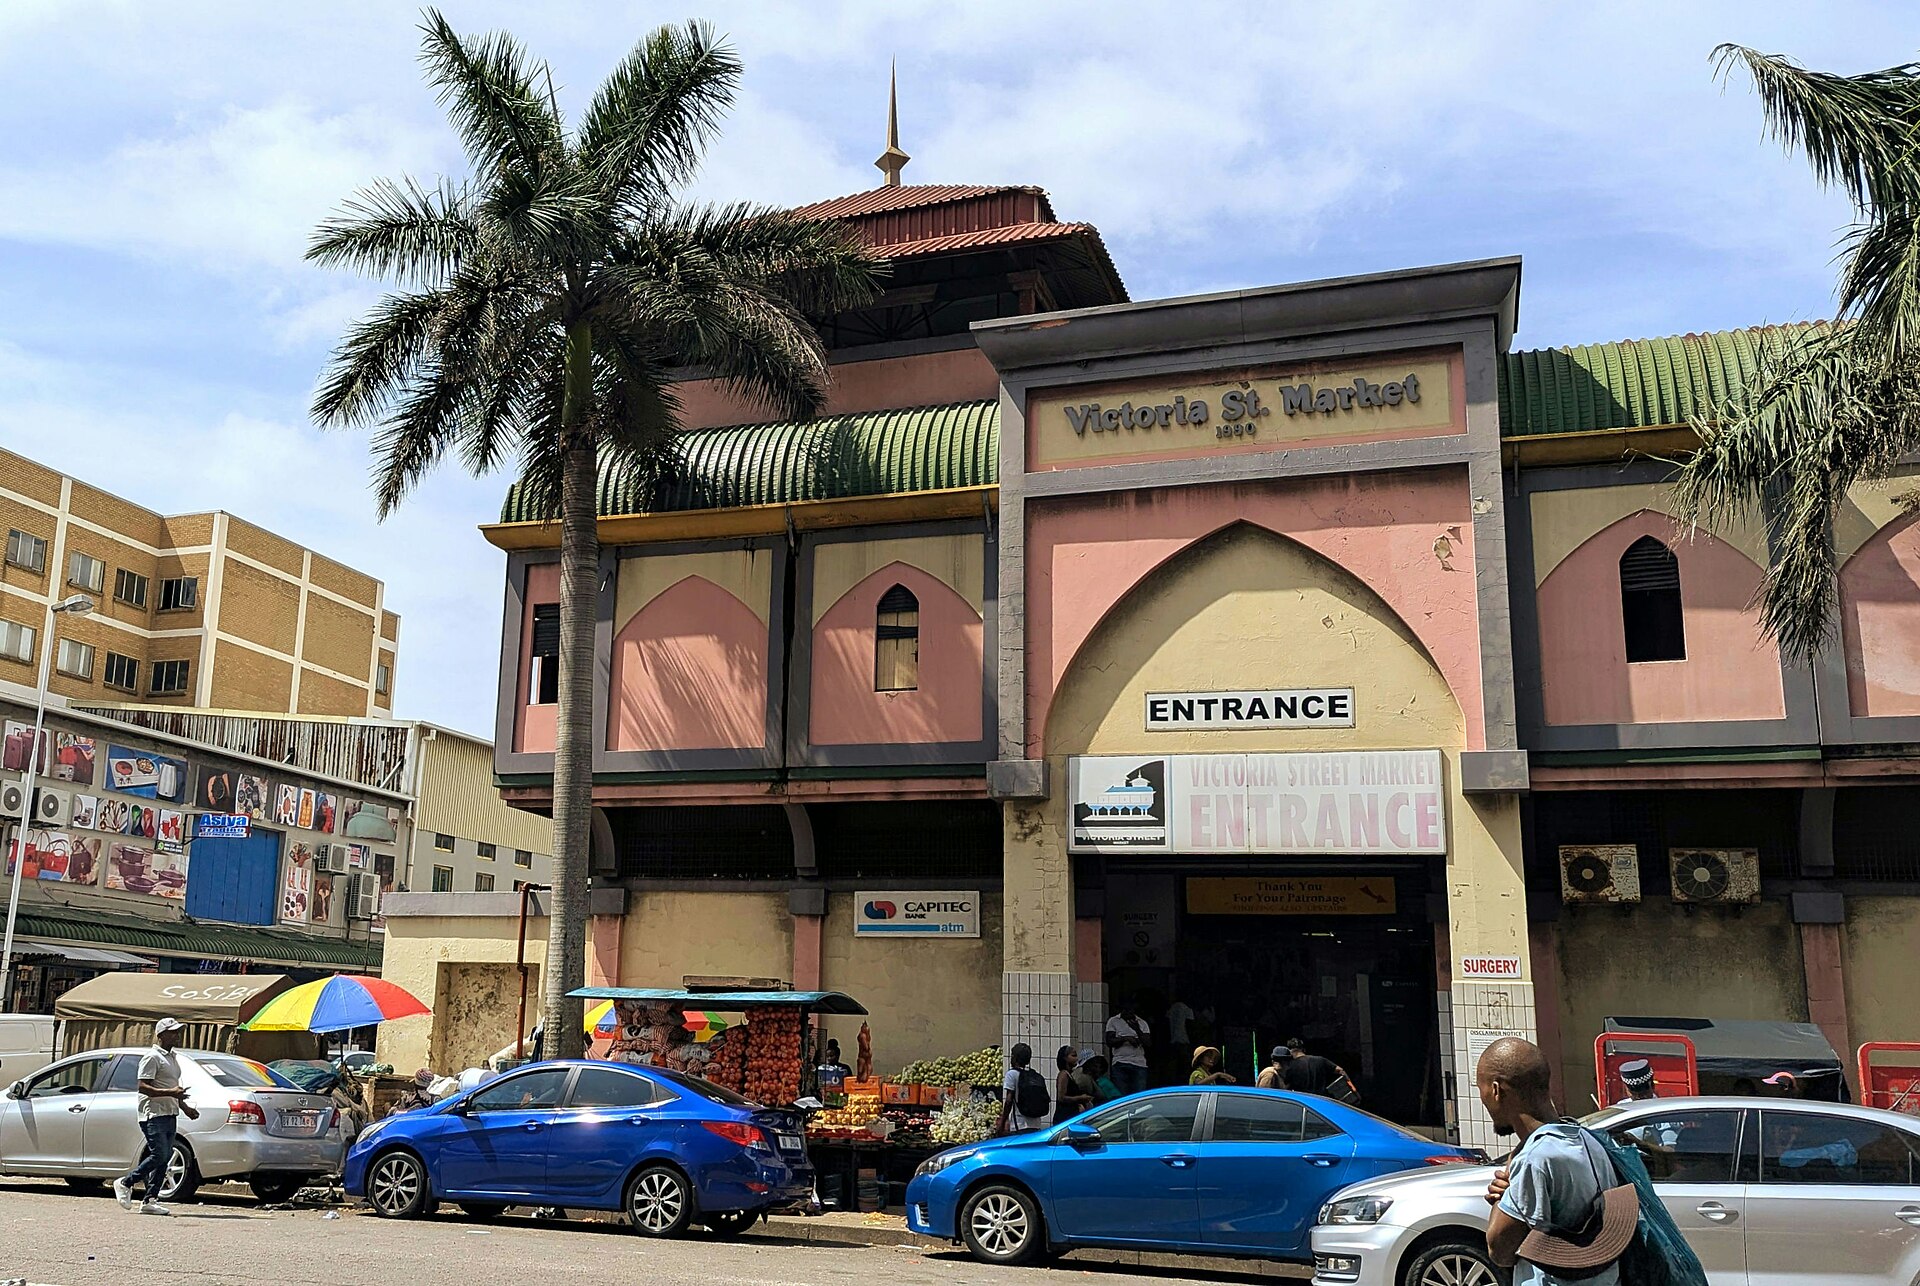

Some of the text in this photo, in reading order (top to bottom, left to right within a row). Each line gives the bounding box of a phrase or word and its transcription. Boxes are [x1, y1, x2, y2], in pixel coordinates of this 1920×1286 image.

[1064, 372, 1421, 435] Victoria St. Market
[1216, 423, 1256, 439] 1990
[1149, 692, 1350, 722] ENTRANCE
[1190, 753, 1436, 787] VICTORIA STREET MARKET
[200, 814, 247, 827] Asiya
[1190, 792, 1440, 849] ENTRANCE
[1257, 881, 1322, 891] Thank You
[1233, 893, 1346, 905] For Your Patronage
[904, 901, 971, 912] CAPITEC
[941, 922, 964, 932] atm
[1463, 959, 1518, 973] SURGERY
